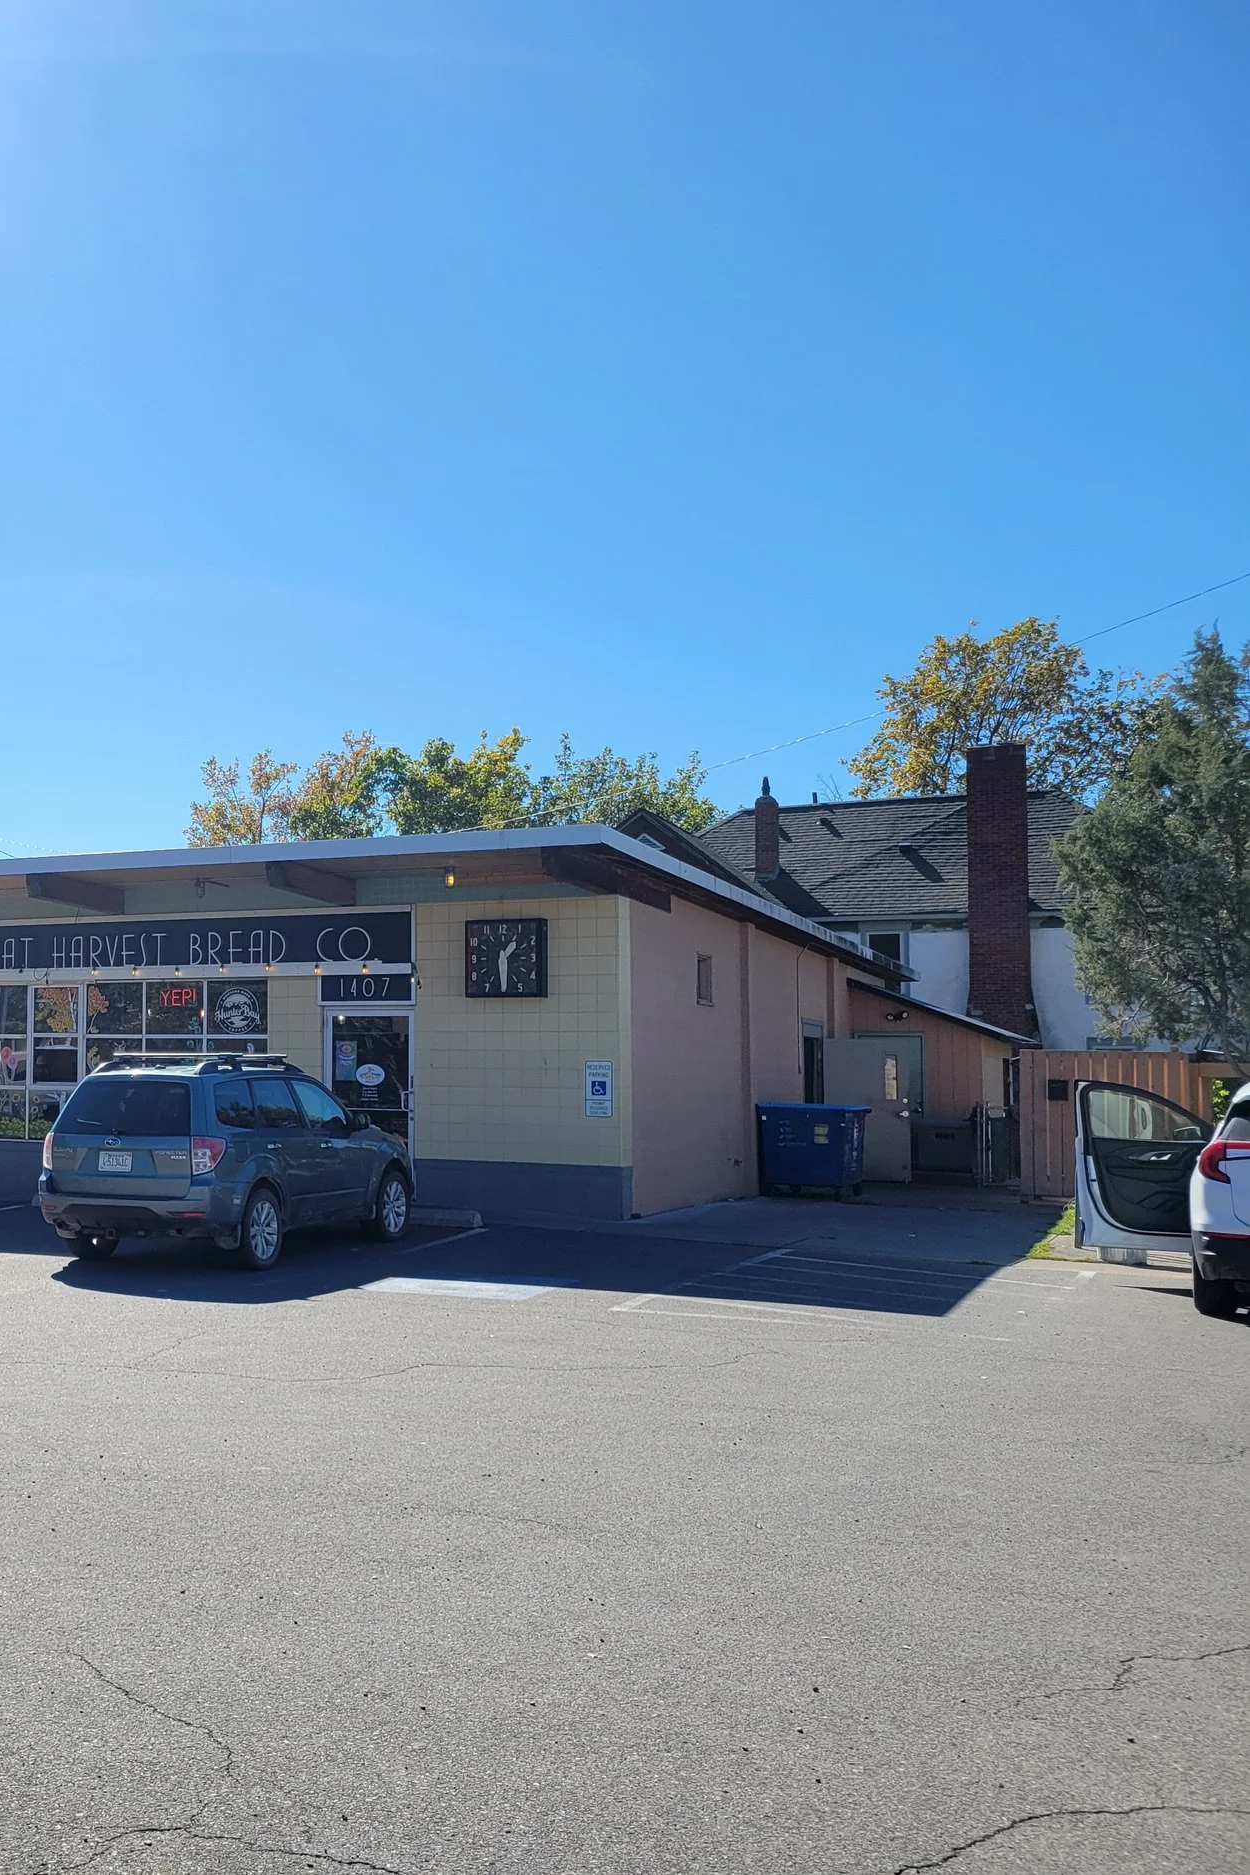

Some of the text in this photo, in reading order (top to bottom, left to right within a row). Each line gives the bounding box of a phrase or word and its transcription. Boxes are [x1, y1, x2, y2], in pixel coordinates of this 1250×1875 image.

[483, 924, 490, 934] 11
[499, 924, 507, 934] 12
[518, 923, 522, 933] 1
[470, 937, 478, 947] 10
[530, 935, 536, 945] 2
[52, 933, 167, 968] HARVEST
[189, 929, 286, 966] BREAD
[471, 954, 477, 964] 9
[530, 953, 536, 963] 3
[471, 971, 477, 981] 8
[530, 970, 536, 980] 4
[339, 977, 390, 998] 1407
[484, 983, 490, 993] 7
[517, 982, 523, 992] 5
